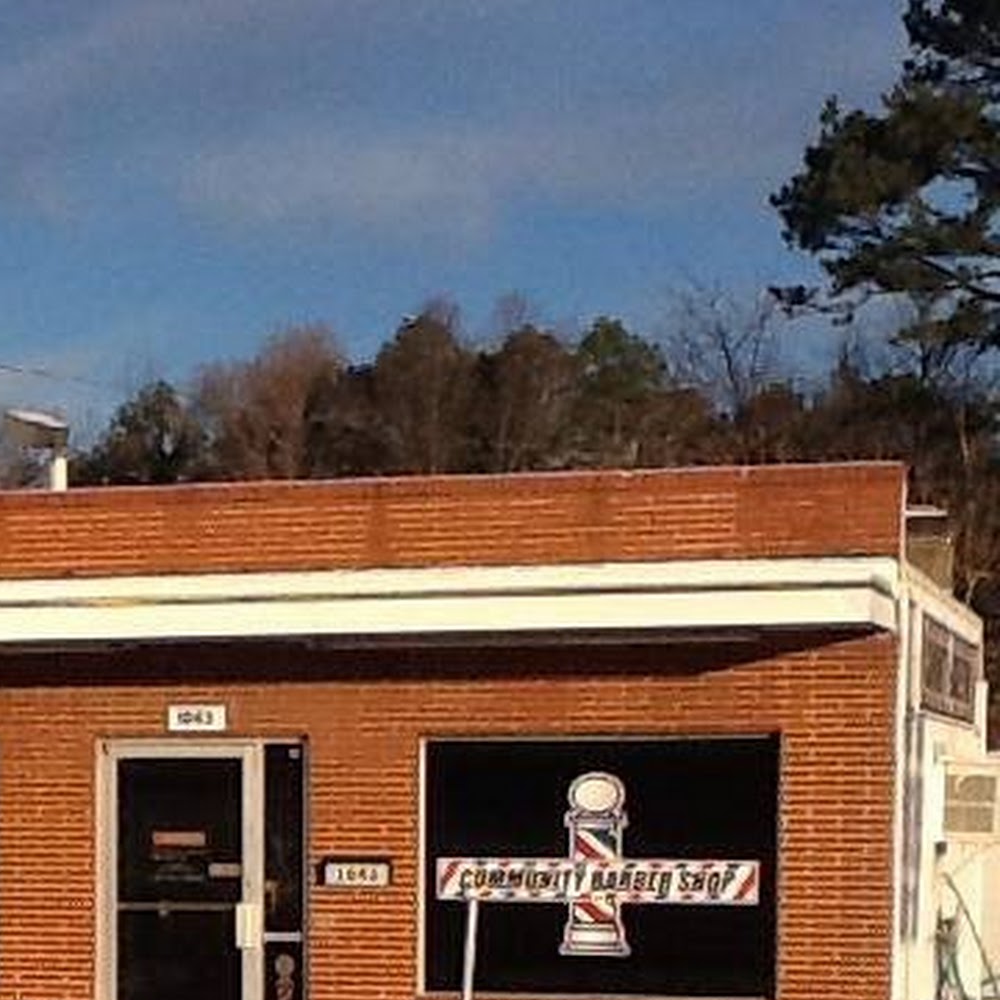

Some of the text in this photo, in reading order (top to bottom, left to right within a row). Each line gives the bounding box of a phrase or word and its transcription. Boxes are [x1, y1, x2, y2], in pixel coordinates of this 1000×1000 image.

[460, 866, 736, 896] COMMUNITY BARBER SHOP
